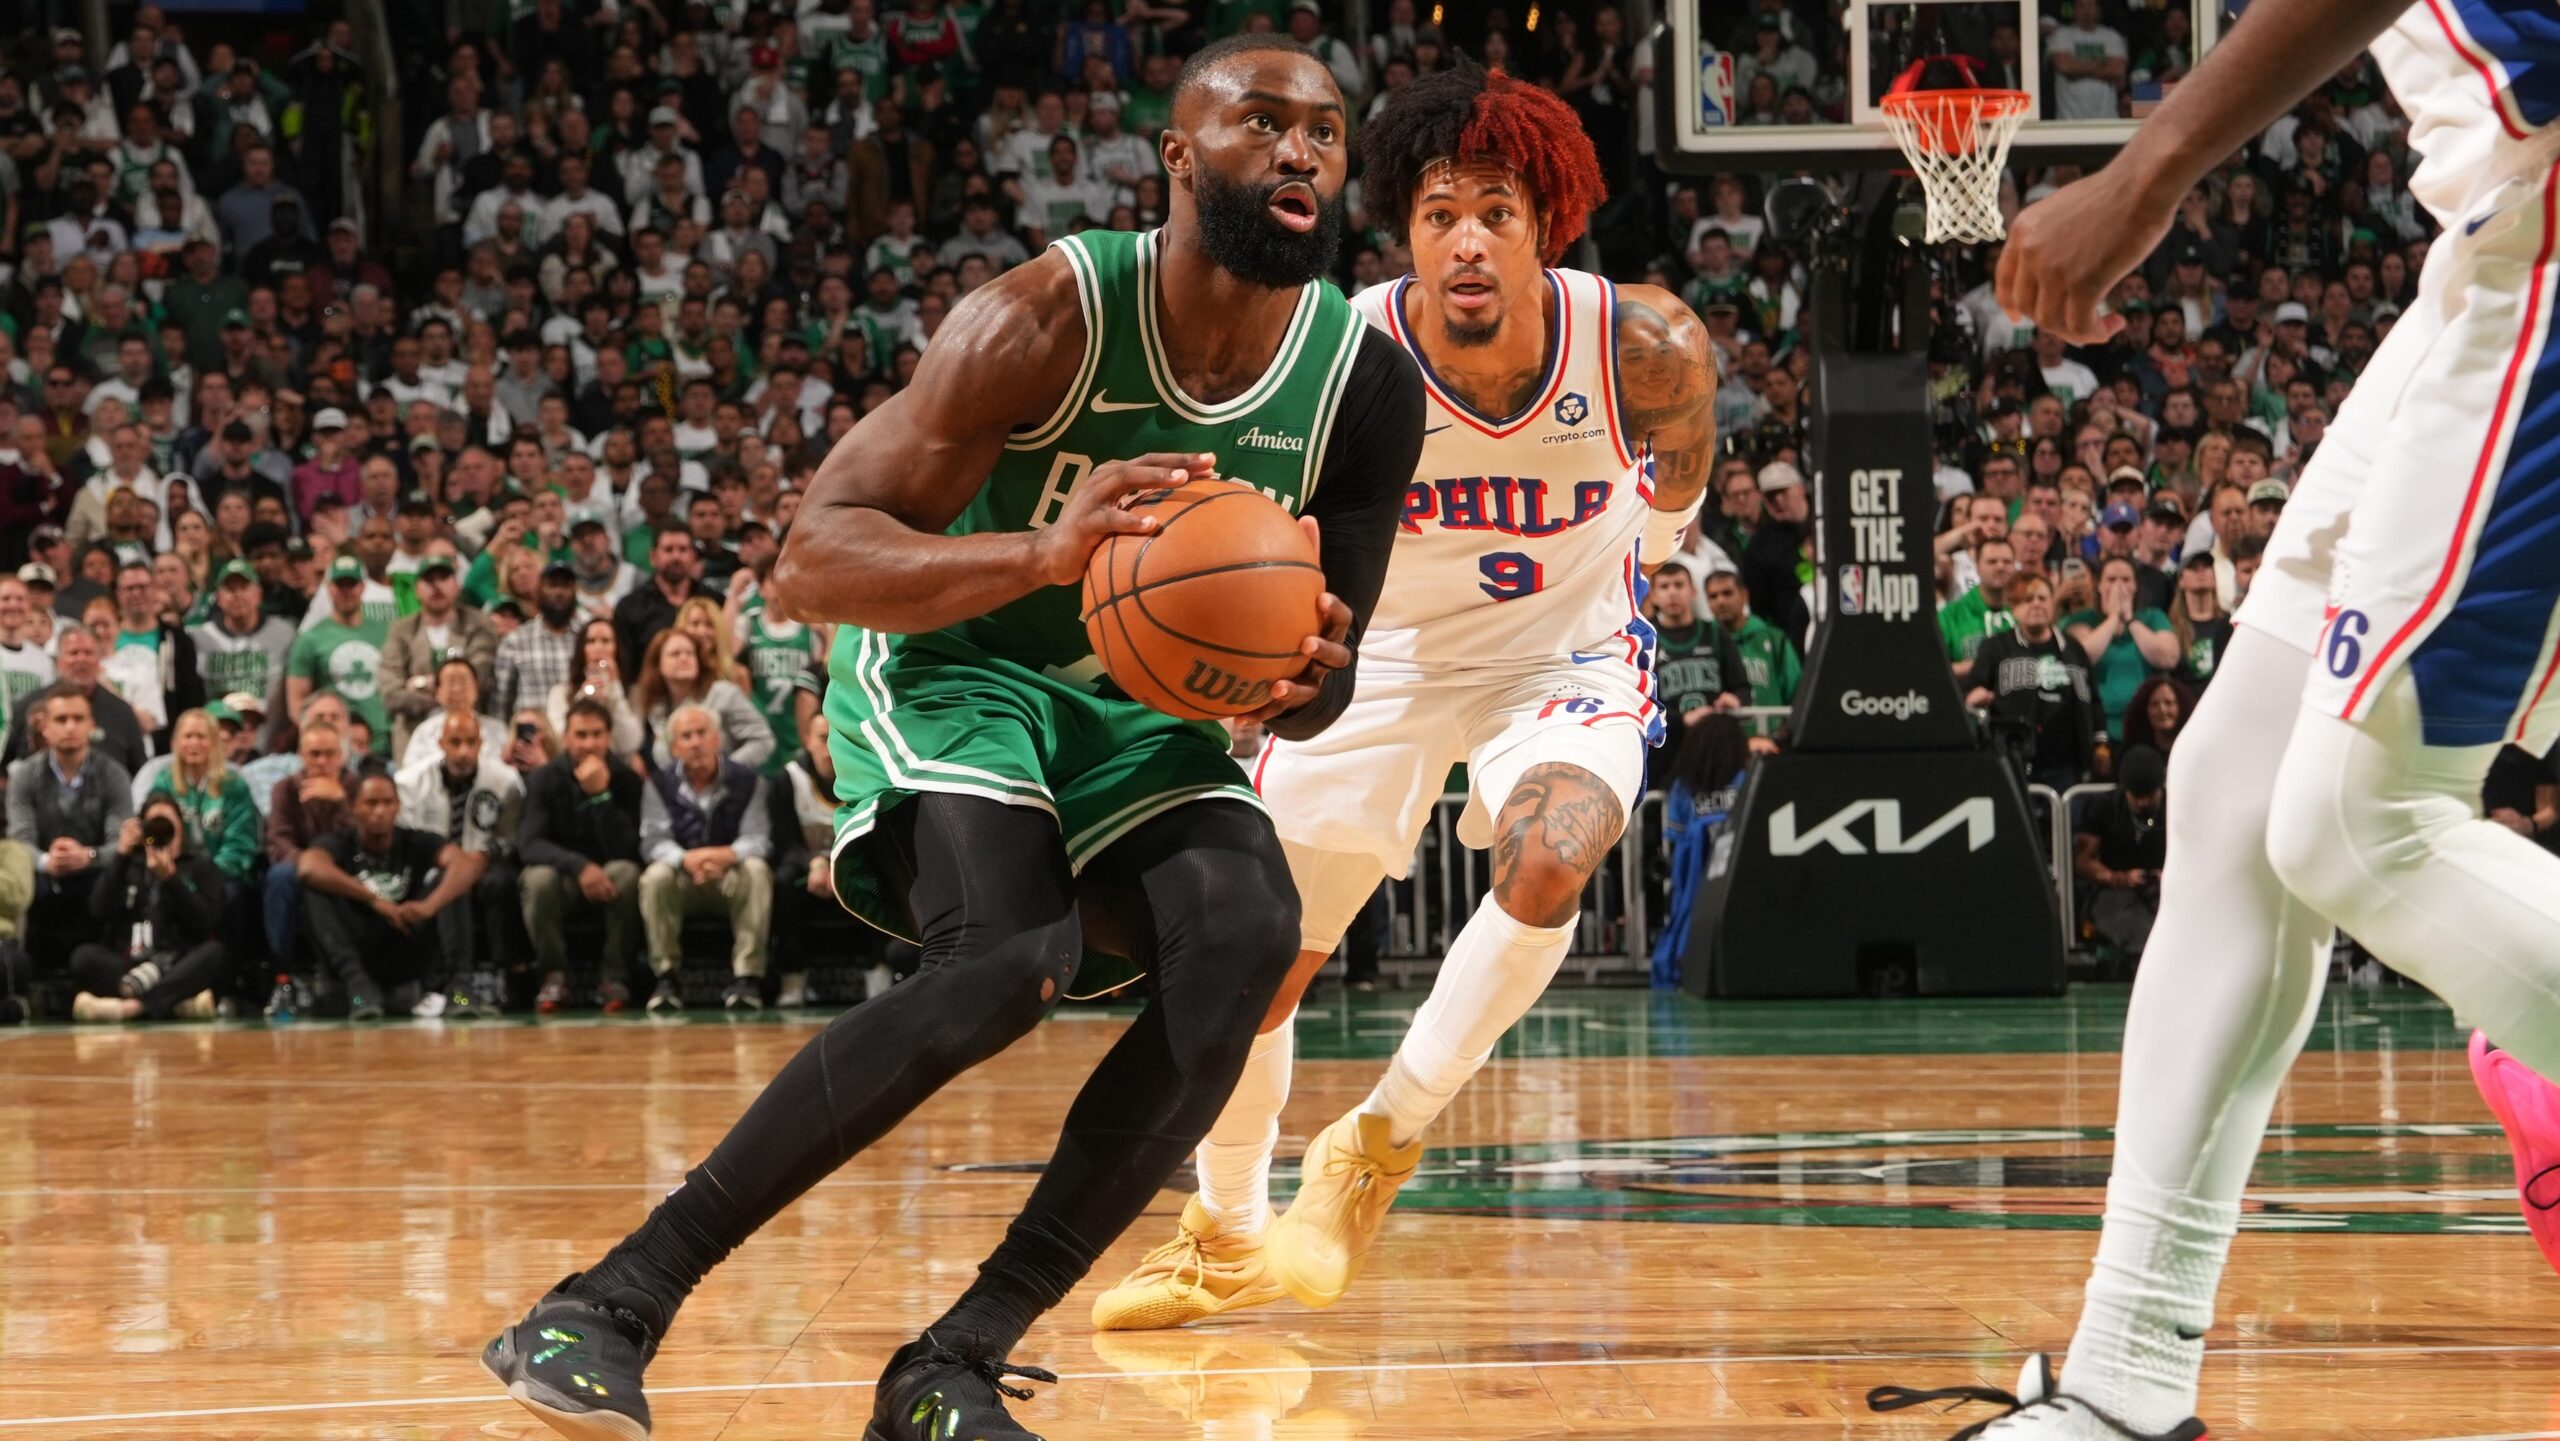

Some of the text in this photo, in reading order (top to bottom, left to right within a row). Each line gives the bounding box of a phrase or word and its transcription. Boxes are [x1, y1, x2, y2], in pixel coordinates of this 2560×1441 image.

[1237, 426, 1304, 451] Amica
[1542, 427, 1606, 444] crypto.com
[1850, 469, 1903, 516] GET
[1850, 517, 1906, 563] THE
[1479, 551, 1543, 602] 9
[1865, 565, 1920, 622] App
[766, 677, 794, 715] 7
[1840, 690, 1930, 721] Google
[1768, 796, 1995, 857] KIA
